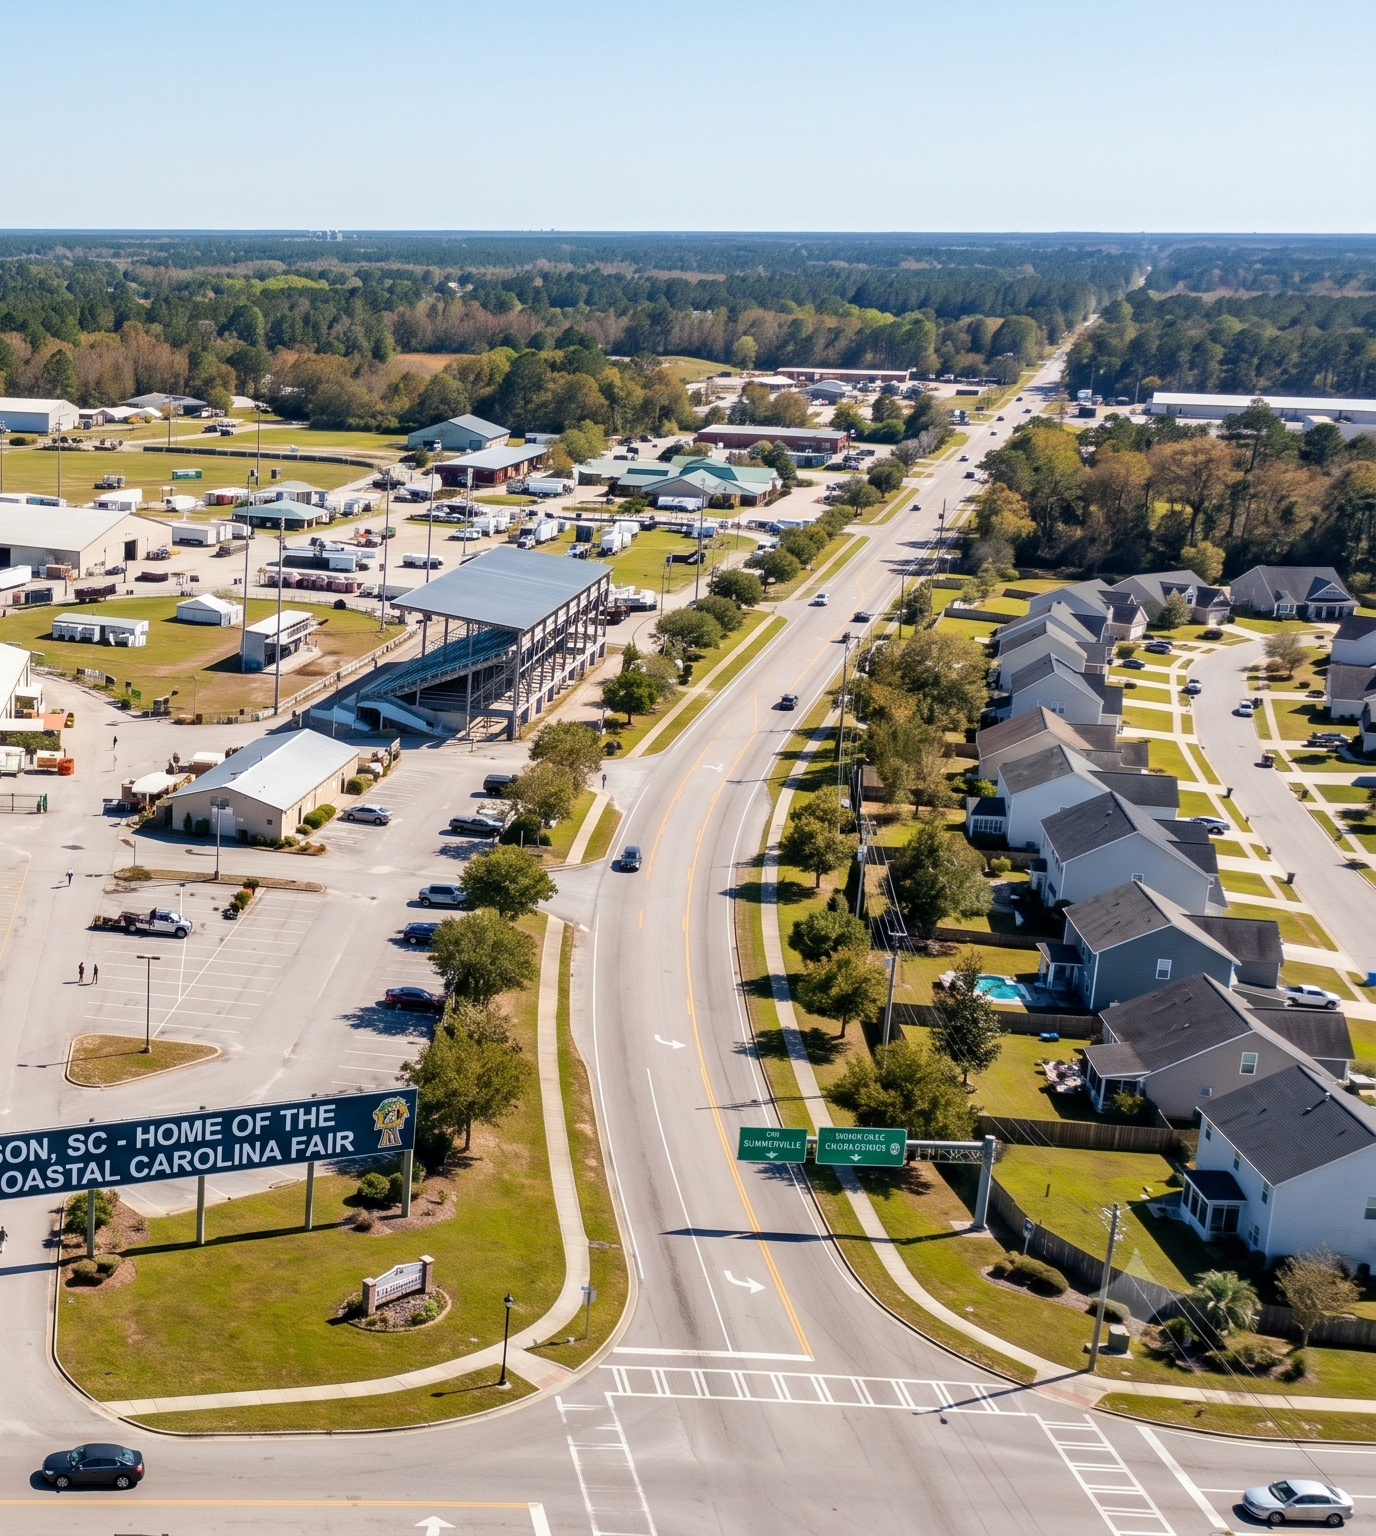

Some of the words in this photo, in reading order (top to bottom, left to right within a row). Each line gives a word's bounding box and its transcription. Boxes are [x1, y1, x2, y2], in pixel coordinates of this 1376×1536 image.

[67, 1132, 107, 1156] SC
[137, 1118, 222, 1148] HOME
[232, 1112, 271, 1136] OF
[280, 1105, 335, 1130] THE
[130, 1140, 282, 1177] CAROLINA
[291, 1131, 354, 1158] FAIR
